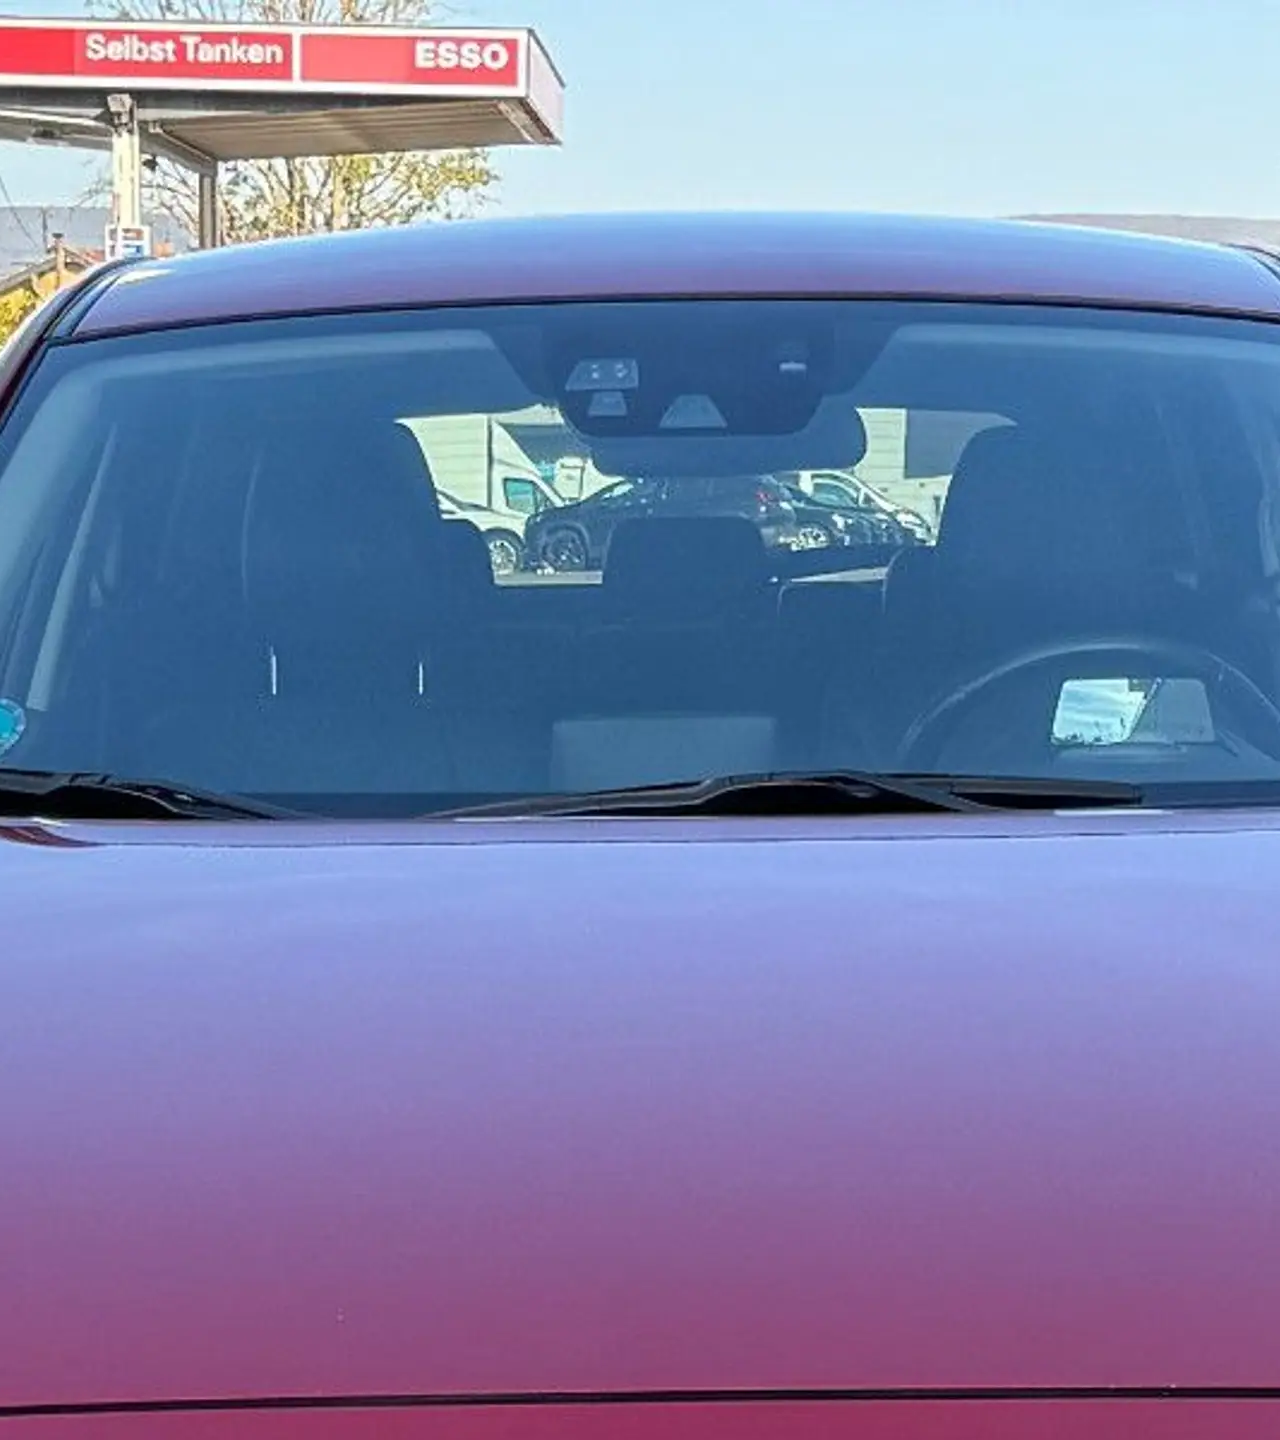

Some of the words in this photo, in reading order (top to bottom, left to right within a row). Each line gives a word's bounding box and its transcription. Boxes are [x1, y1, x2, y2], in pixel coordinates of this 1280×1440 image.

[85, 32, 177, 62] Selbst
[180, 35, 284, 64] Tanken
[414, 40, 509, 70] ESSO
